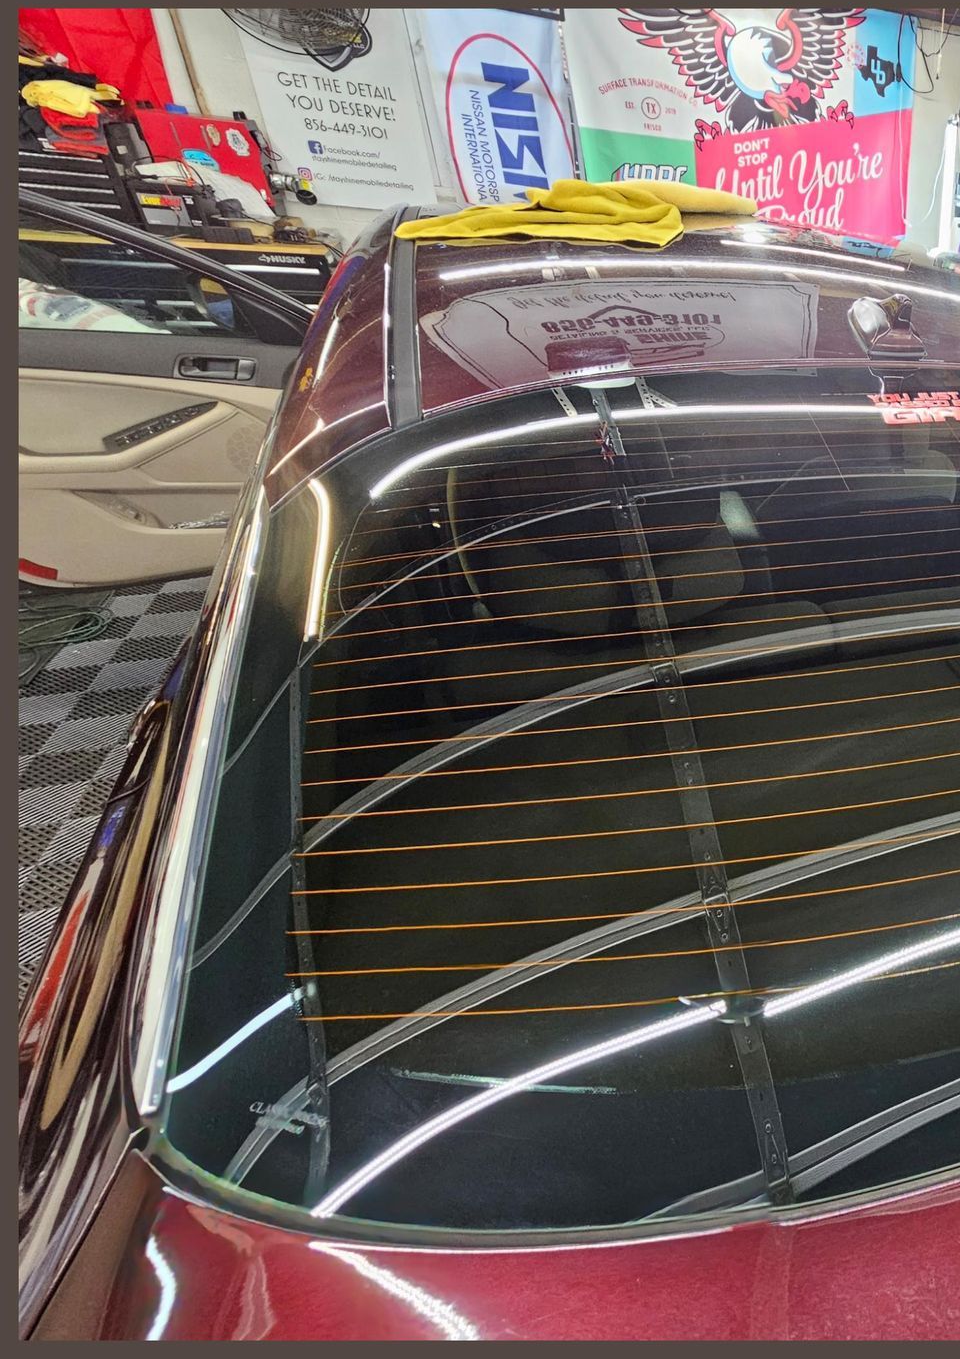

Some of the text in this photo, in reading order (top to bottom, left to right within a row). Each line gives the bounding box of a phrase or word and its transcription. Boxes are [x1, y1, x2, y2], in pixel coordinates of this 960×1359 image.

[277, 71, 397, 102] GET THE DETAIL
[598, 78, 628, 95] SURFACE
[628, 77, 687, 99] TRANSFORMATION
[286, 93, 397, 122] YOU DESERVE!
[645, 102, 657, 115] TX
[304, 118, 388, 140] 856-449-3101
[468, 88, 501, 203] NISSAN MOTORSP
[733, 137, 770, 155] DON'T
[460, 113, 489, 202] INTERNATIONA
[737, 152, 769, 168] STOP
[788, 143, 884, 212] You're
[271, 255, 306, 265] HUSKY
[867, 393, 911, 403] YOU
[913, 392, 960, 401] JUST
